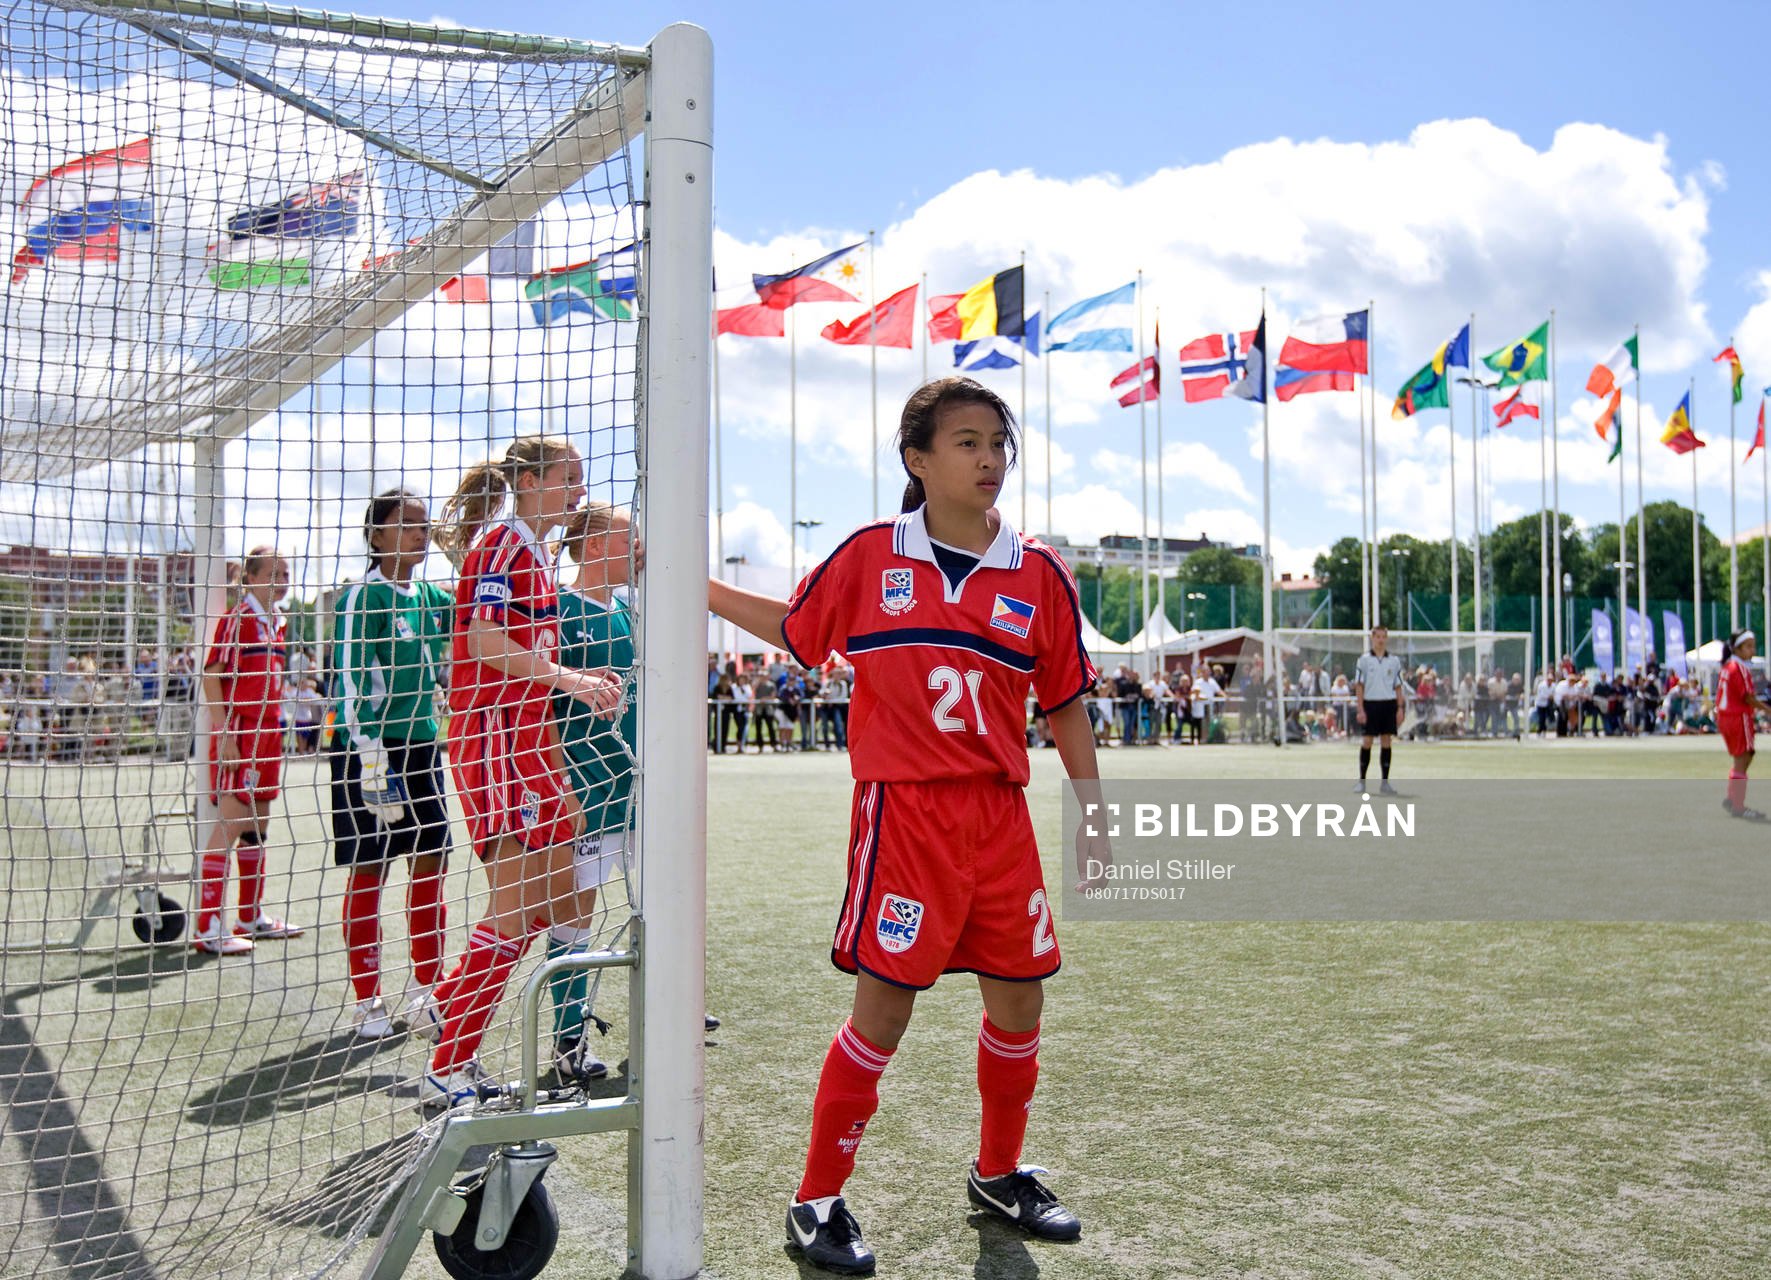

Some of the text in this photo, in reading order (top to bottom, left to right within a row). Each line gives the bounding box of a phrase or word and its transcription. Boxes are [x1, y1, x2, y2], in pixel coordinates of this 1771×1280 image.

[885, 587, 911, 598] MFC
[879, 599, 918, 616] EUROPE 2008
[991, 618, 1026, 636] PHILIPPINES
[927, 665, 988, 735] 21
[878, 918, 916, 941] MFC
